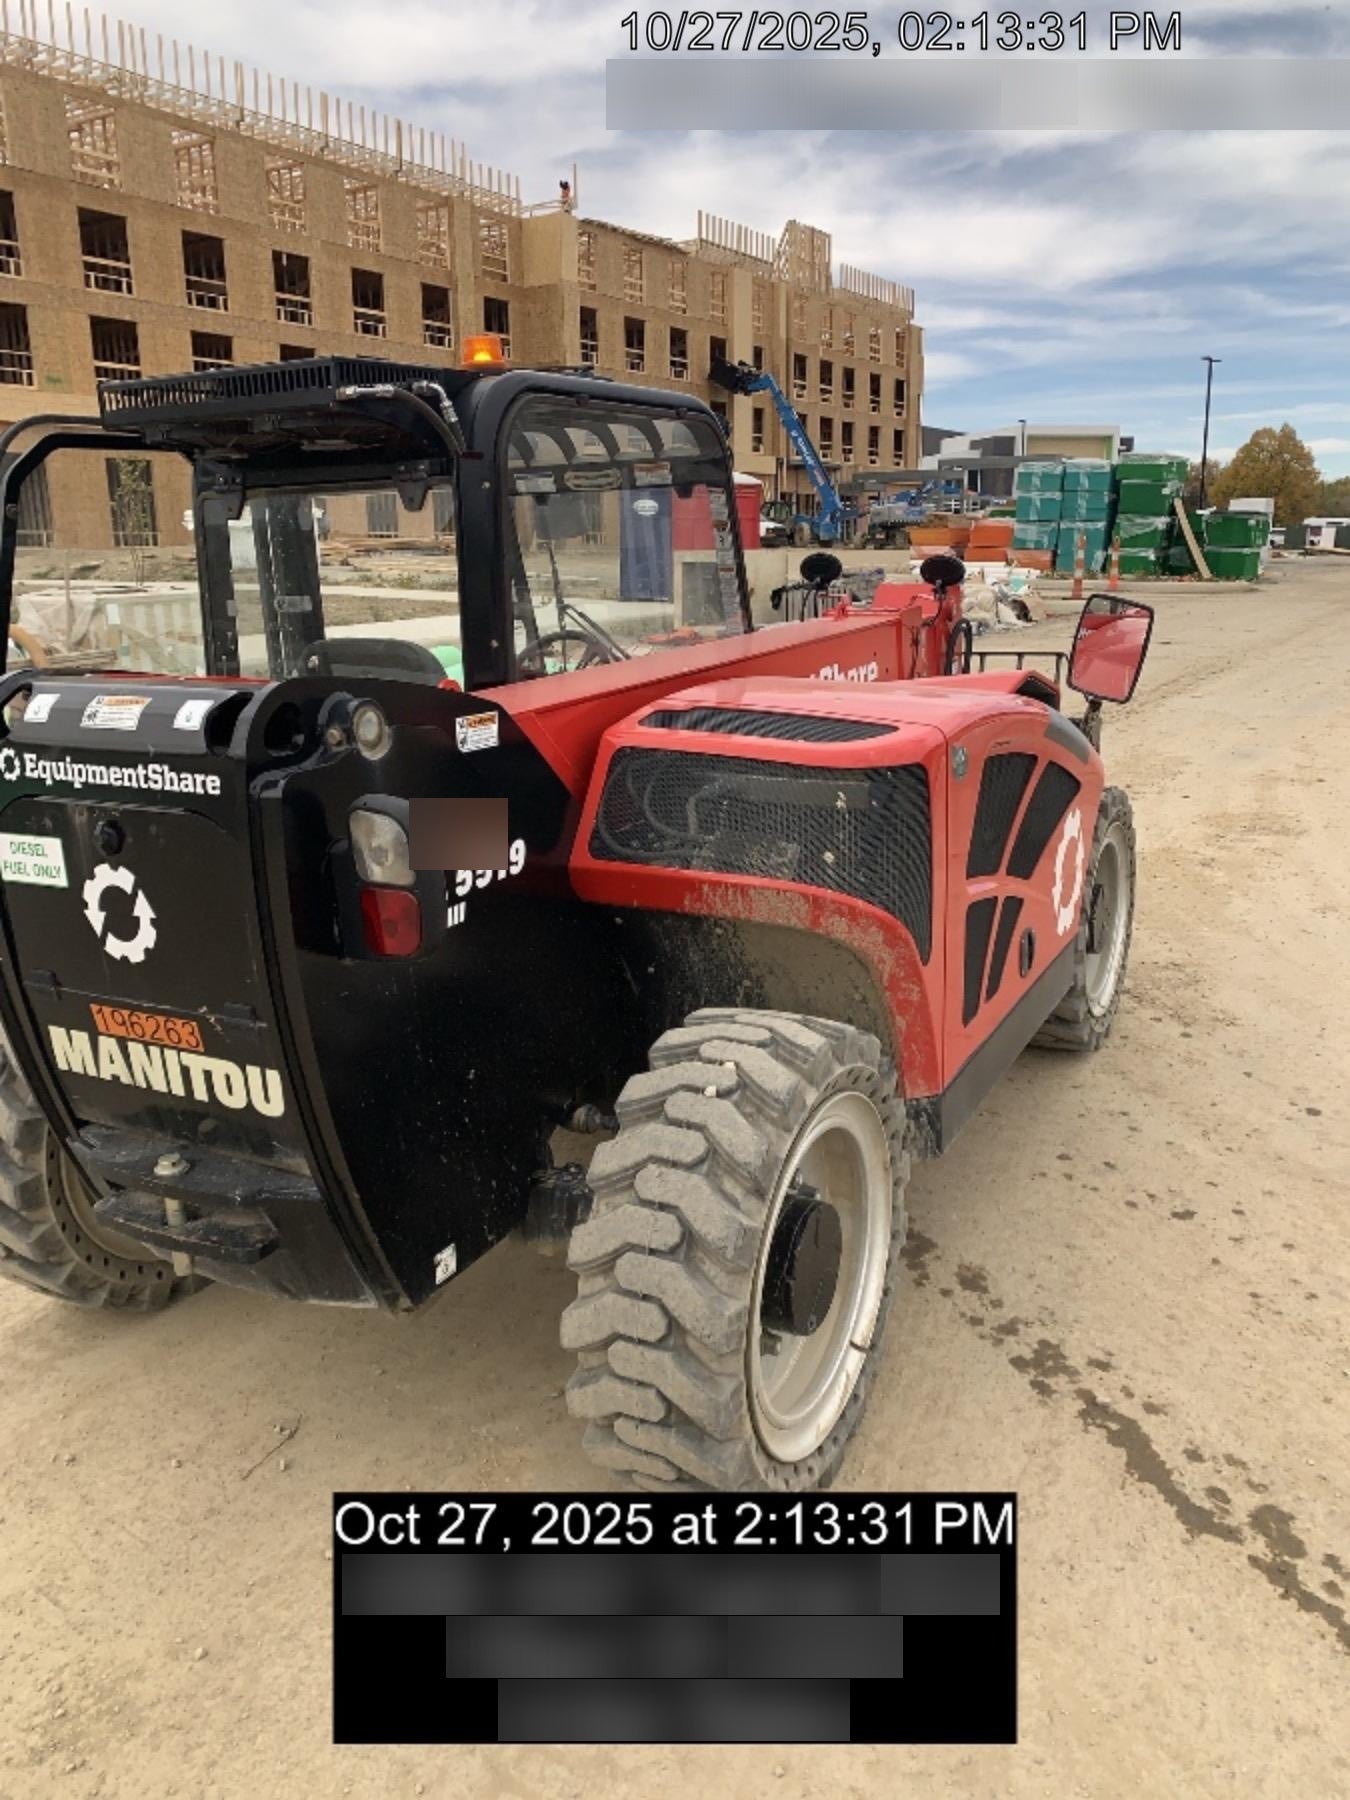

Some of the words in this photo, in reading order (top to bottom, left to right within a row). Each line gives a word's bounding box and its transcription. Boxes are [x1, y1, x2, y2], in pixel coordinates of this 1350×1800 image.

[24, 753, 221, 795] EquipmentShare
[4, 860, 30, 876] FUEL
[32, 863, 61, 879] ONLY
[10, 841, 48, 858] DIESEL
[96, 1007, 200, 1049] 196263
[48, 1024, 285, 1117] MANITOU
